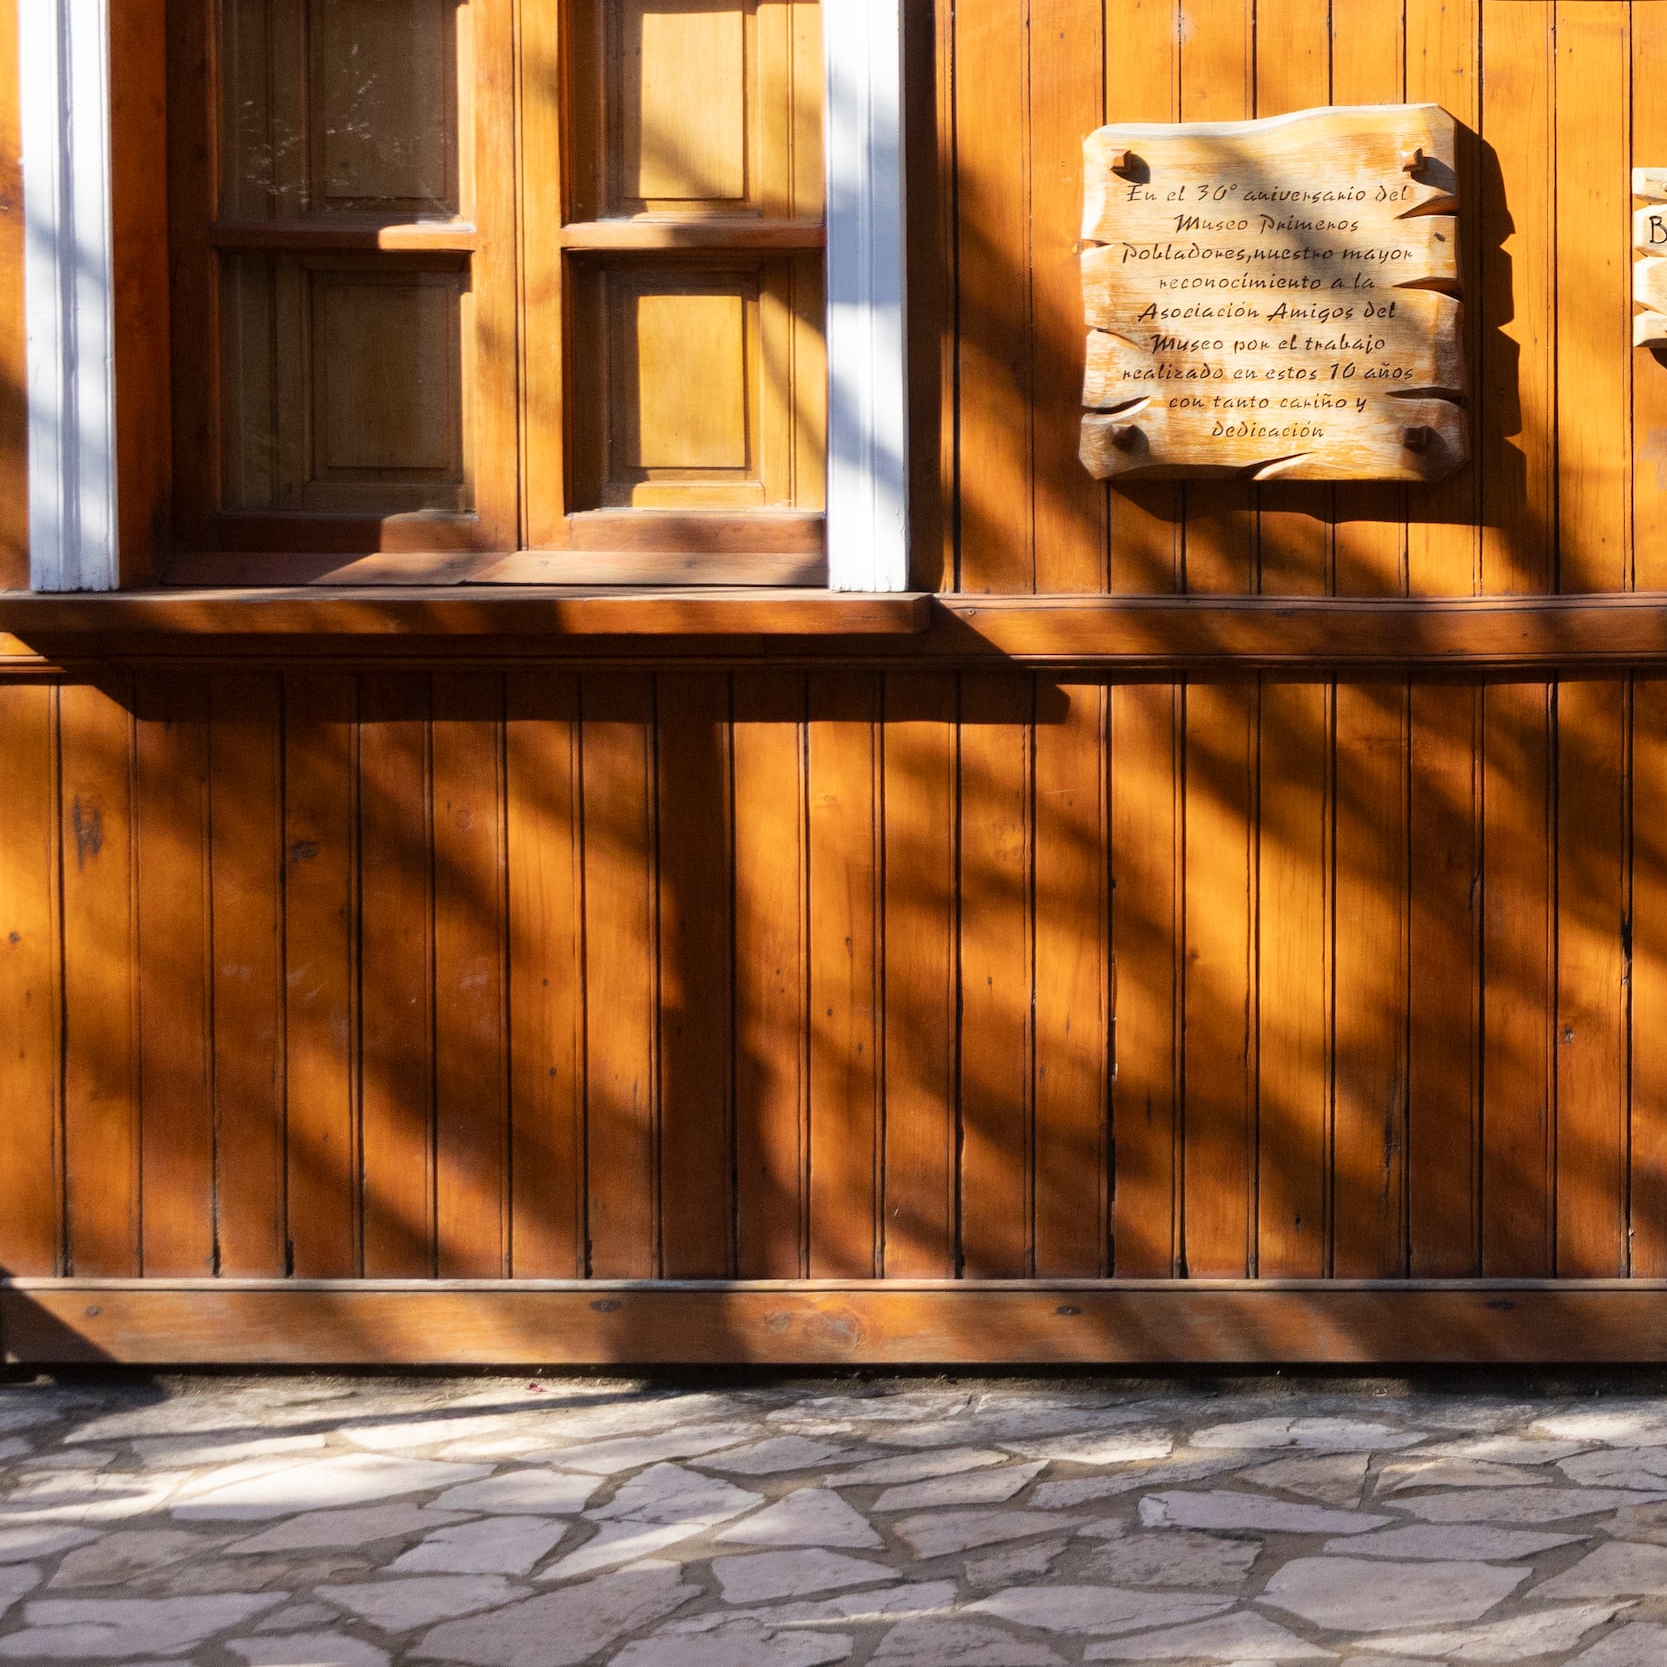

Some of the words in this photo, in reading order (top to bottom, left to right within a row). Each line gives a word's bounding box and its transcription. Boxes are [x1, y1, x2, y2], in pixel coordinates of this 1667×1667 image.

[1126, 184, 1156, 202] En
[1167, 187, 1184, 202] el
[1244, 187, 1366, 203] aniversario
[1376, 186, 1408, 202] del
[1174, 215, 1248, 232] Museo
[1260, 214, 1358, 234] Primeros
[1342, 248, 1413, 264] mayor
[1332, 278, 1345, 289] a
[1354, 274, 1375, 289] la
[1138, 302, 1259, 322] Asociación
[1267, 302, 1353, 323] Amigos
[1364, 302, 1396, 319] del
[1151, 334, 1223, 352] Museo
[1234, 339, 1269, 354] por
[1279, 335, 1298, 350] el
[1306, 334, 1385, 354] trabajo
[1122, 365, 1223, 381] realizado
[1233, 368, 1258, 380] en
[1265, 366, 1317, 380] estos
[1330, 364, 1356, 380] 10
[1364, 365, 1413, 381] años
[1169, 396, 1204, 409] con
[1213, 395, 1269, 409] tanto
[1279, 394, 1347, 408] cariño
[1356, 398, 1367, 412] y
[1212, 422, 1325, 438] dedicación
